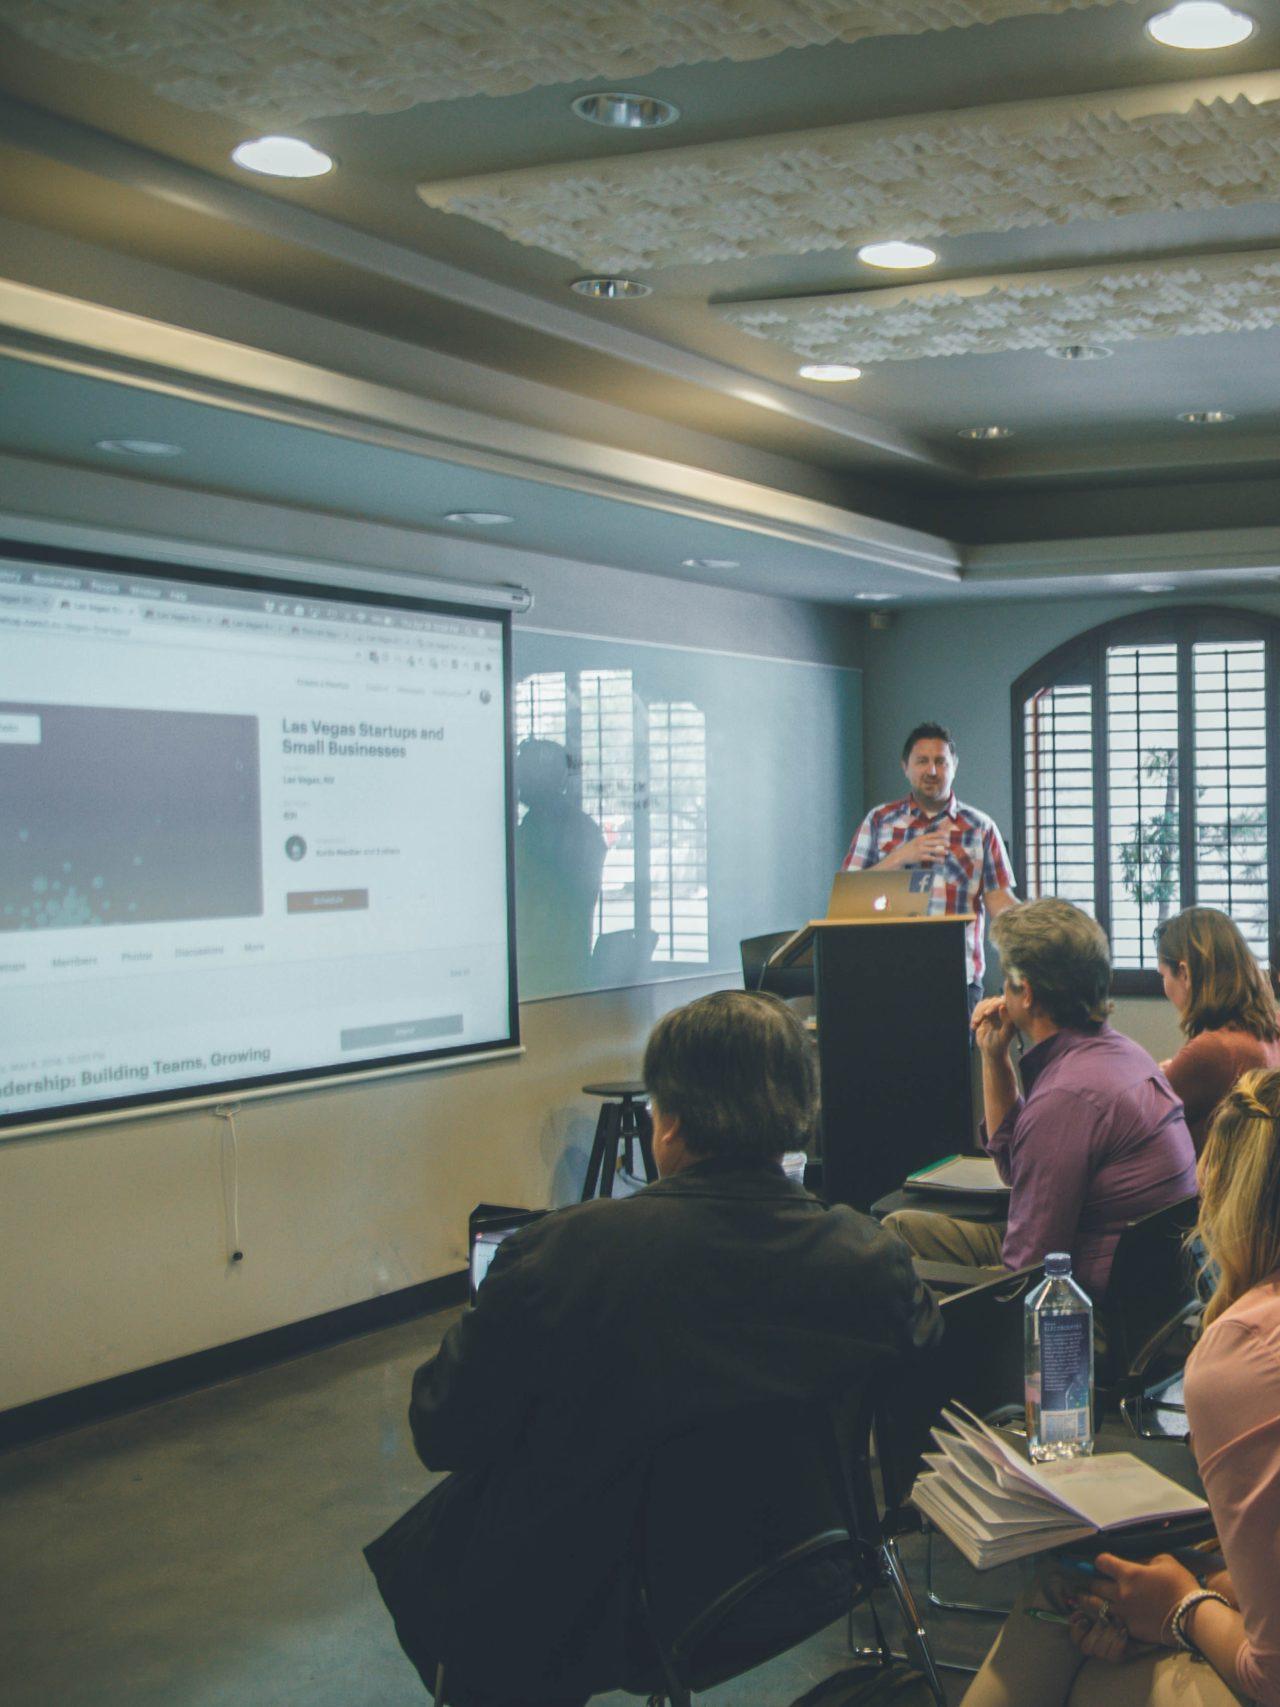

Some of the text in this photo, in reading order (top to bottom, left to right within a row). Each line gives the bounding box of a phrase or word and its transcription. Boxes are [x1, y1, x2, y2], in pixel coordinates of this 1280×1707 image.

[282, 718, 445, 741] Las Vegas Startups and
[282, 738, 407, 758] Small Businesses
[0, 1047, 272, 1098] dership: Building Teams, Growing
